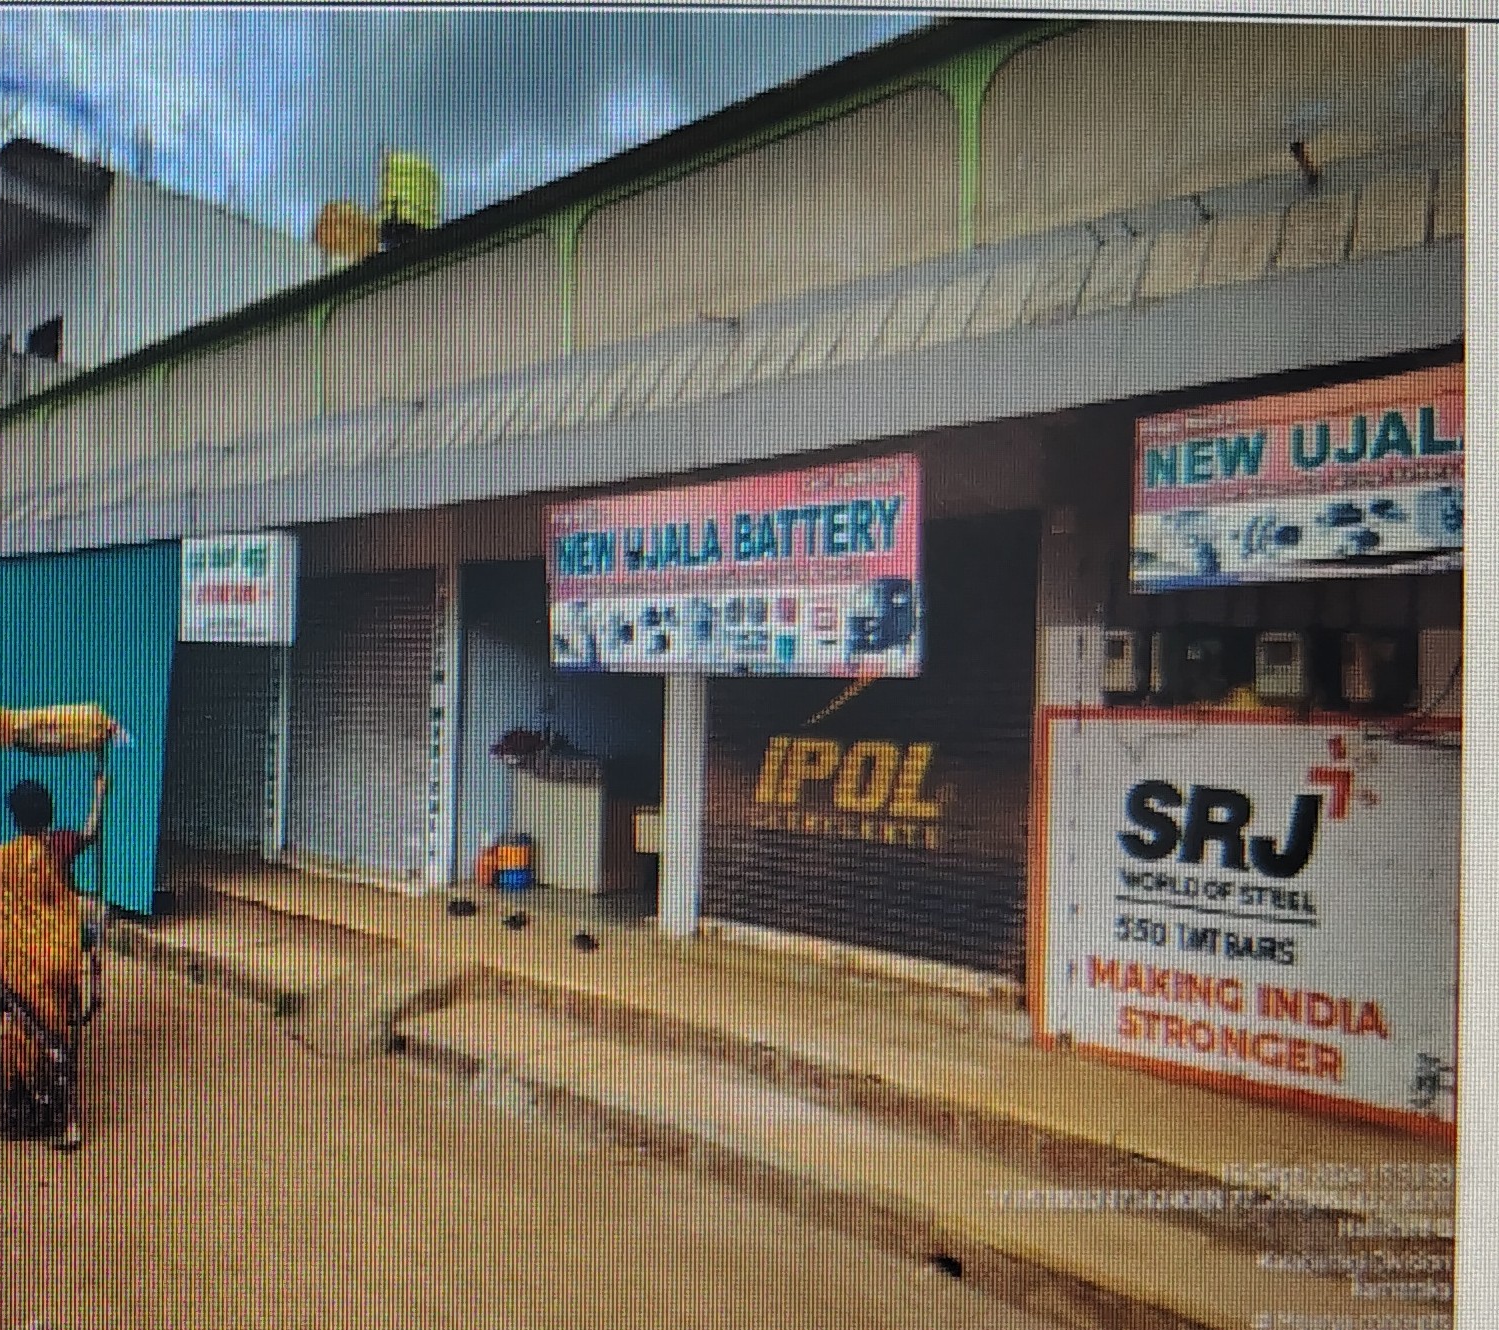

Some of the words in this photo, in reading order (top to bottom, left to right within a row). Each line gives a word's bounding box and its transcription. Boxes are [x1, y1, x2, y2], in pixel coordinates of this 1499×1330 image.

[1144, 429, 1266, 489] NEW
[1290, 404, 1464, 471] UJAL
[556, 530, 616, 577] NEW
[733, 496, 904, 562] BATTERY
[1116, 778, 1324, 879] SRJ
[1116, 867, 1200, 900] WORLD
[1203, 877, 1233, 903] OF
[1239, 883, 1318, 915] STEEL
[1115, 915, 1168, 947] 550
[1224, 930, 1297, 966] BARS
[1087, 954, 1244, 1014] MAKING
[1257, 982, 1389, 1040] INDIA
[1117, 1004, 1346, 1083] STRONGER
